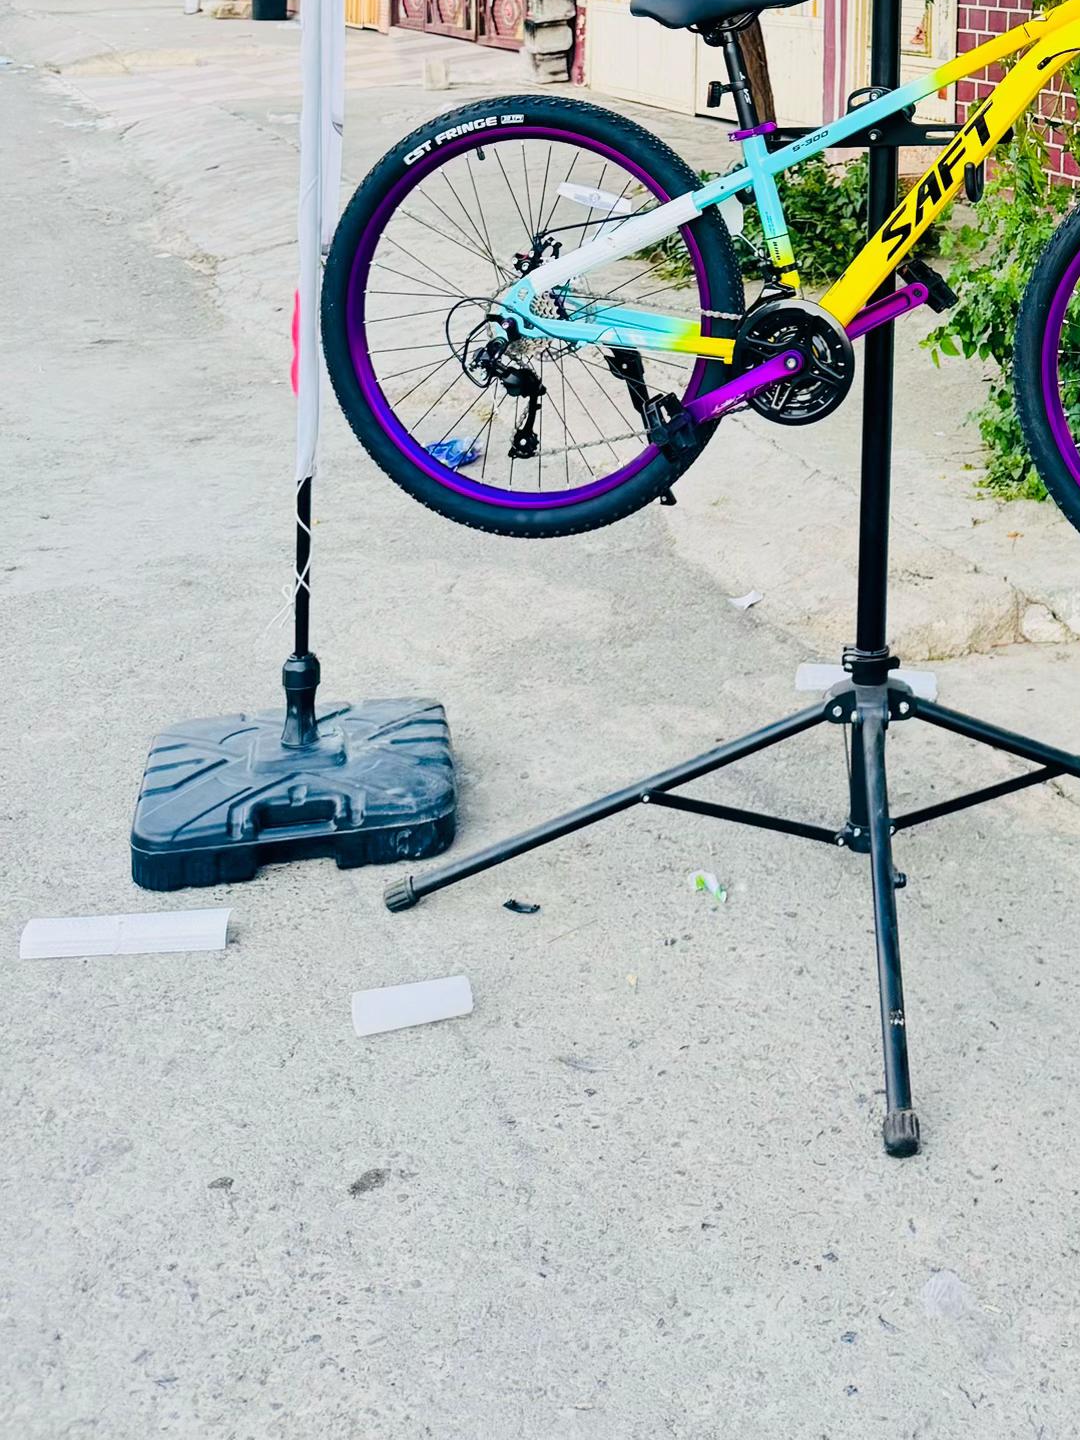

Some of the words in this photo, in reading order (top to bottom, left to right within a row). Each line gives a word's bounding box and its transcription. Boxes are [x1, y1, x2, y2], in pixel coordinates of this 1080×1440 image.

[403, 139, 432, 166] CST
[435, 116, 498, 146] FRINGE
[881, 99, 993, 262] SAFT
